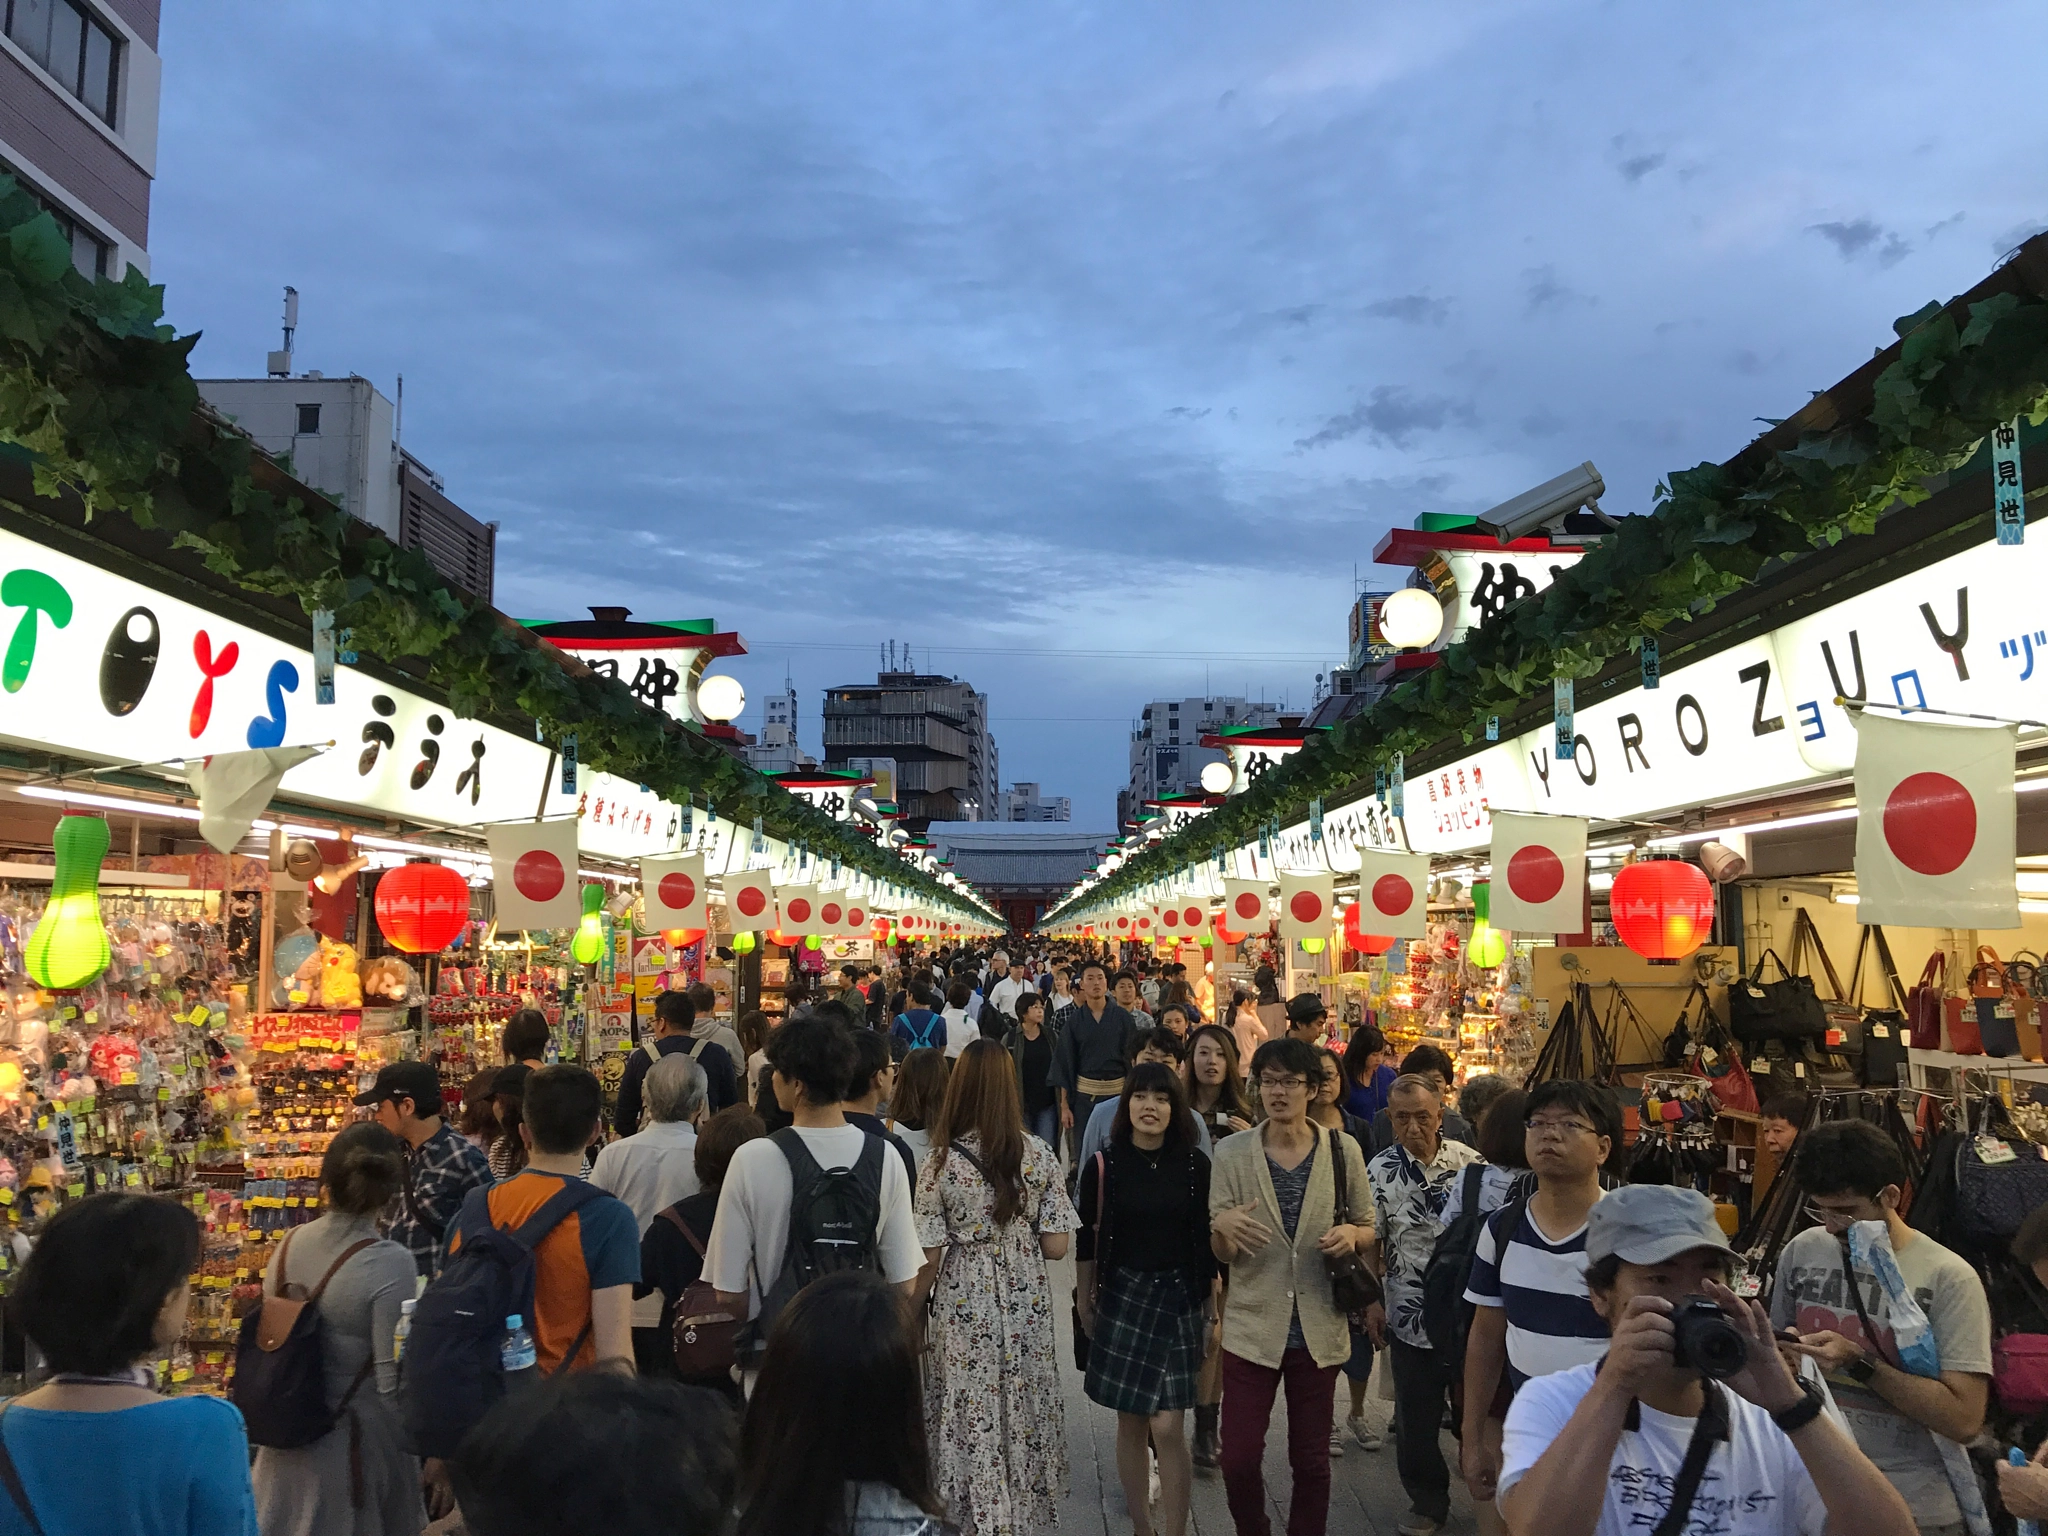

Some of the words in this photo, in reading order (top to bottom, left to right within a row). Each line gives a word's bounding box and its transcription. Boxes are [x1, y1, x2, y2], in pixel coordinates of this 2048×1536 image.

[1995, 424, 2021, 525] 仲見世
[1, 569, 299, 750] TOYS
[562, 732, 576, 783] 見世
